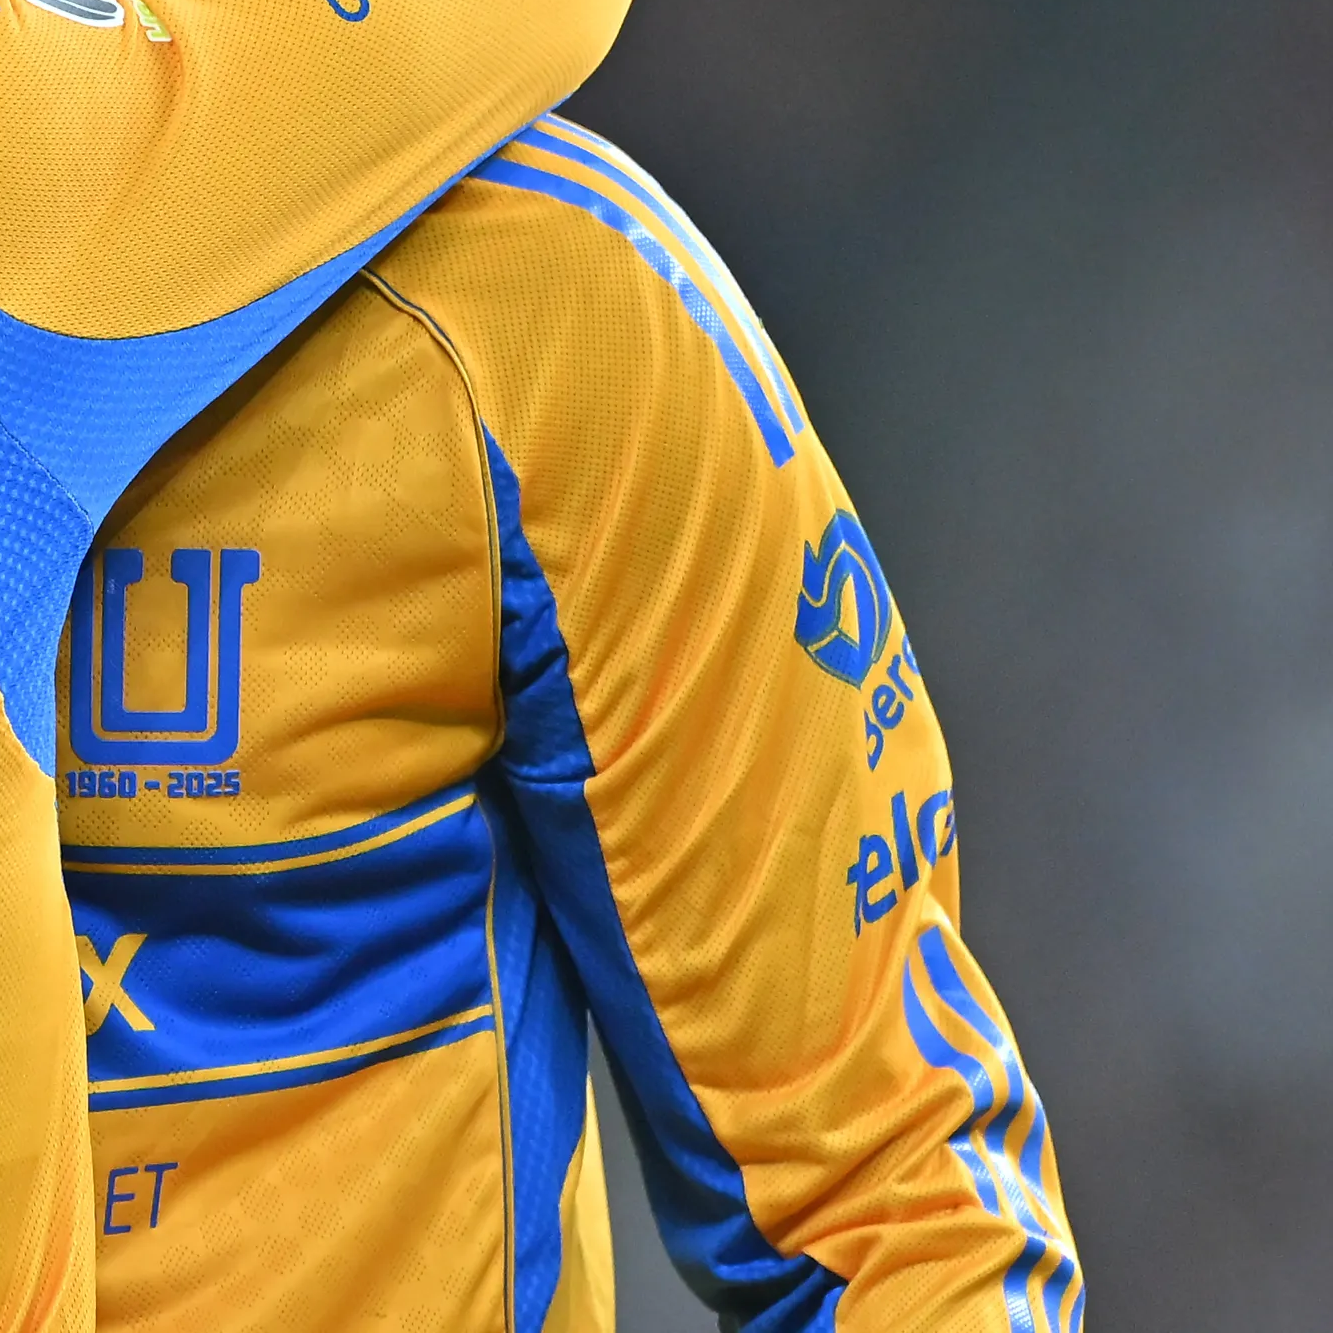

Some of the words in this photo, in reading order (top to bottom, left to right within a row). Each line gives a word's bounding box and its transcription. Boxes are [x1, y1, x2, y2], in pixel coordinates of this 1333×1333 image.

[65, 770, 137, 799] 1960
[166, 770, 241, 799] 2025
[102, 1161, 179, 1235] ET
